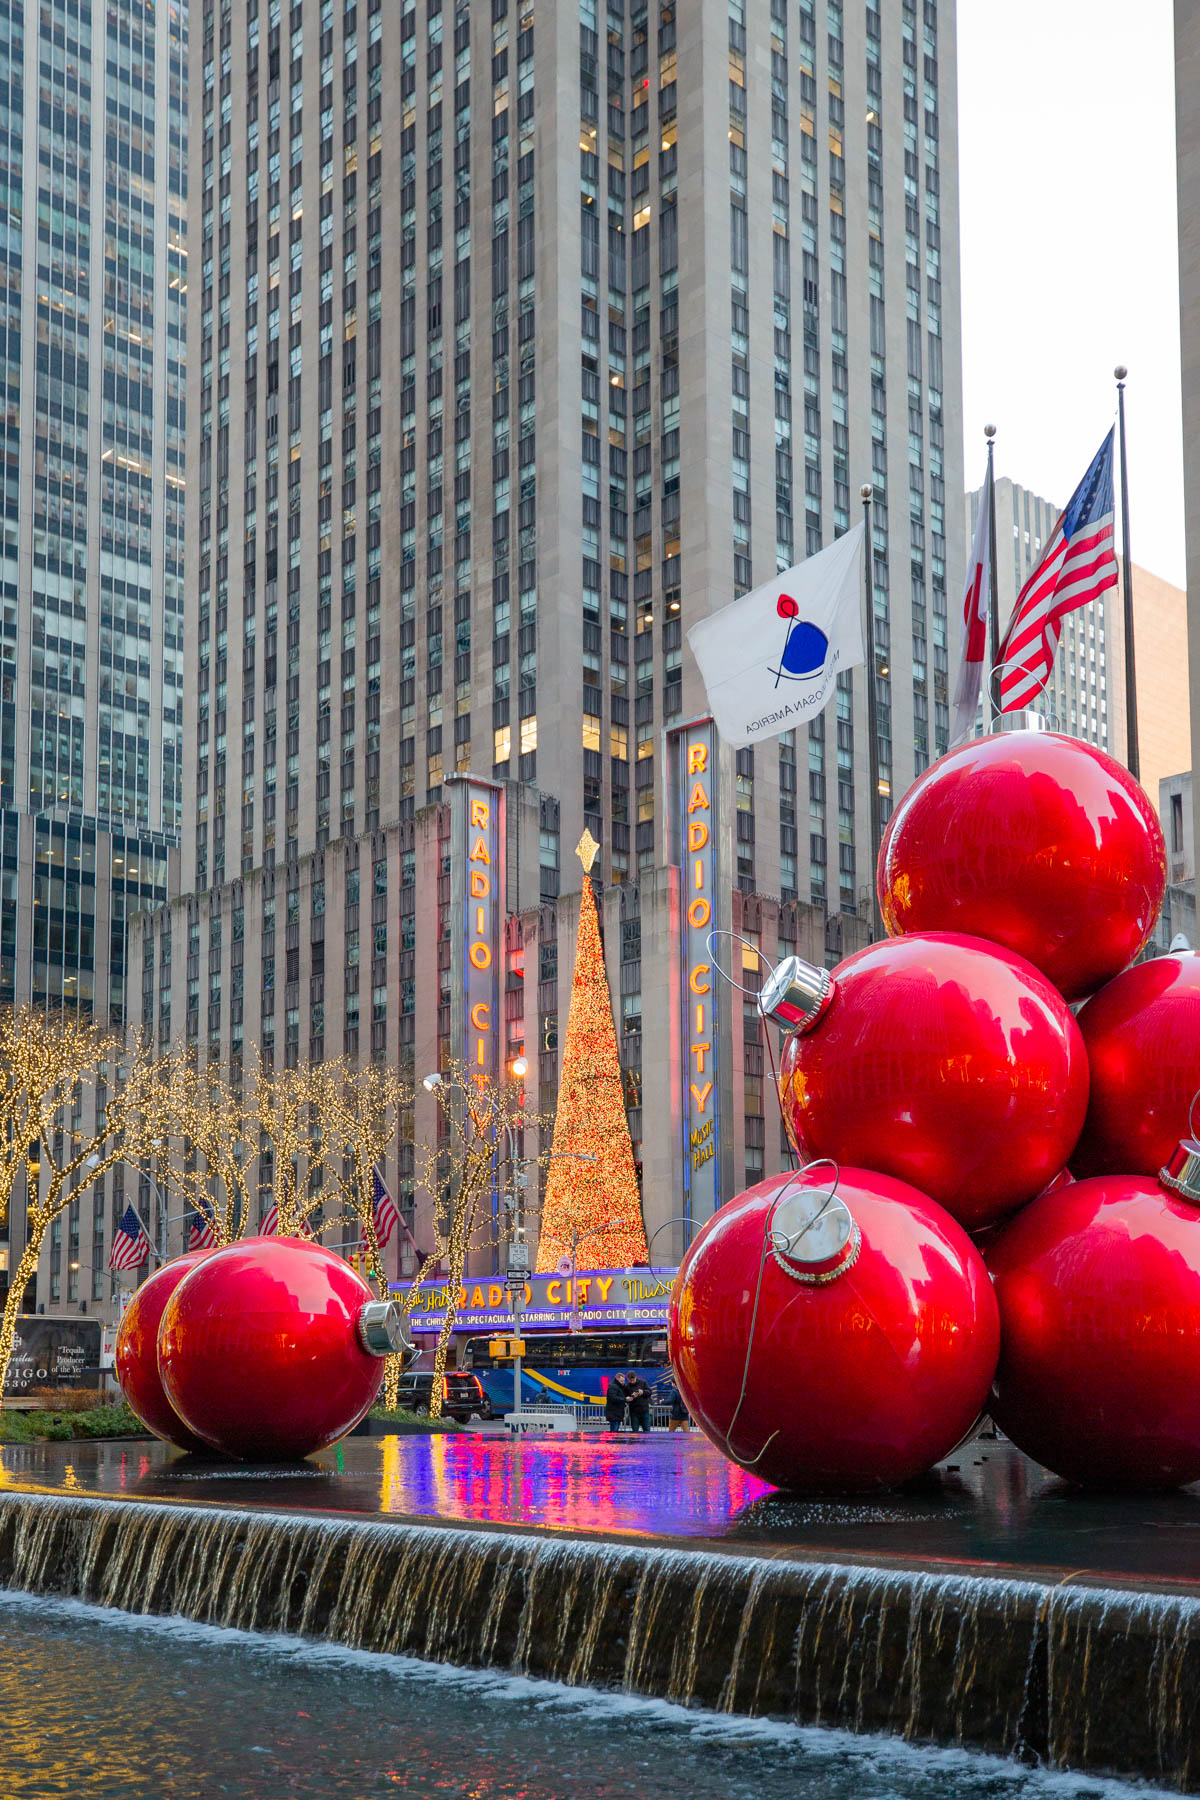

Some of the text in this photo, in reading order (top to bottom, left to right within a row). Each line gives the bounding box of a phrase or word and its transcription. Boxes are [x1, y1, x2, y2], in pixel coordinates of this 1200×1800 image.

[470, 799, 492, 970] RADIO
[688, 742, 712, 1113] RADIO CITY
[471, 1002, 491, 1137] CITY
[690, 1119, 714, 1152] MUSIC
[694, 1142, 715, 1172] HALL
[392, 1291, 424, 1308] Mic
[547, 1277, 613, 1304] CITY
[411, 1318, 422, 1326] THE
[426, 1316, 463, 1326] CHRISAS
[520, 1312, 555, 1322] STARRING
[606, 1309, 627, 1319] CITY
[635, 1308, 669, 1319] ROCK
